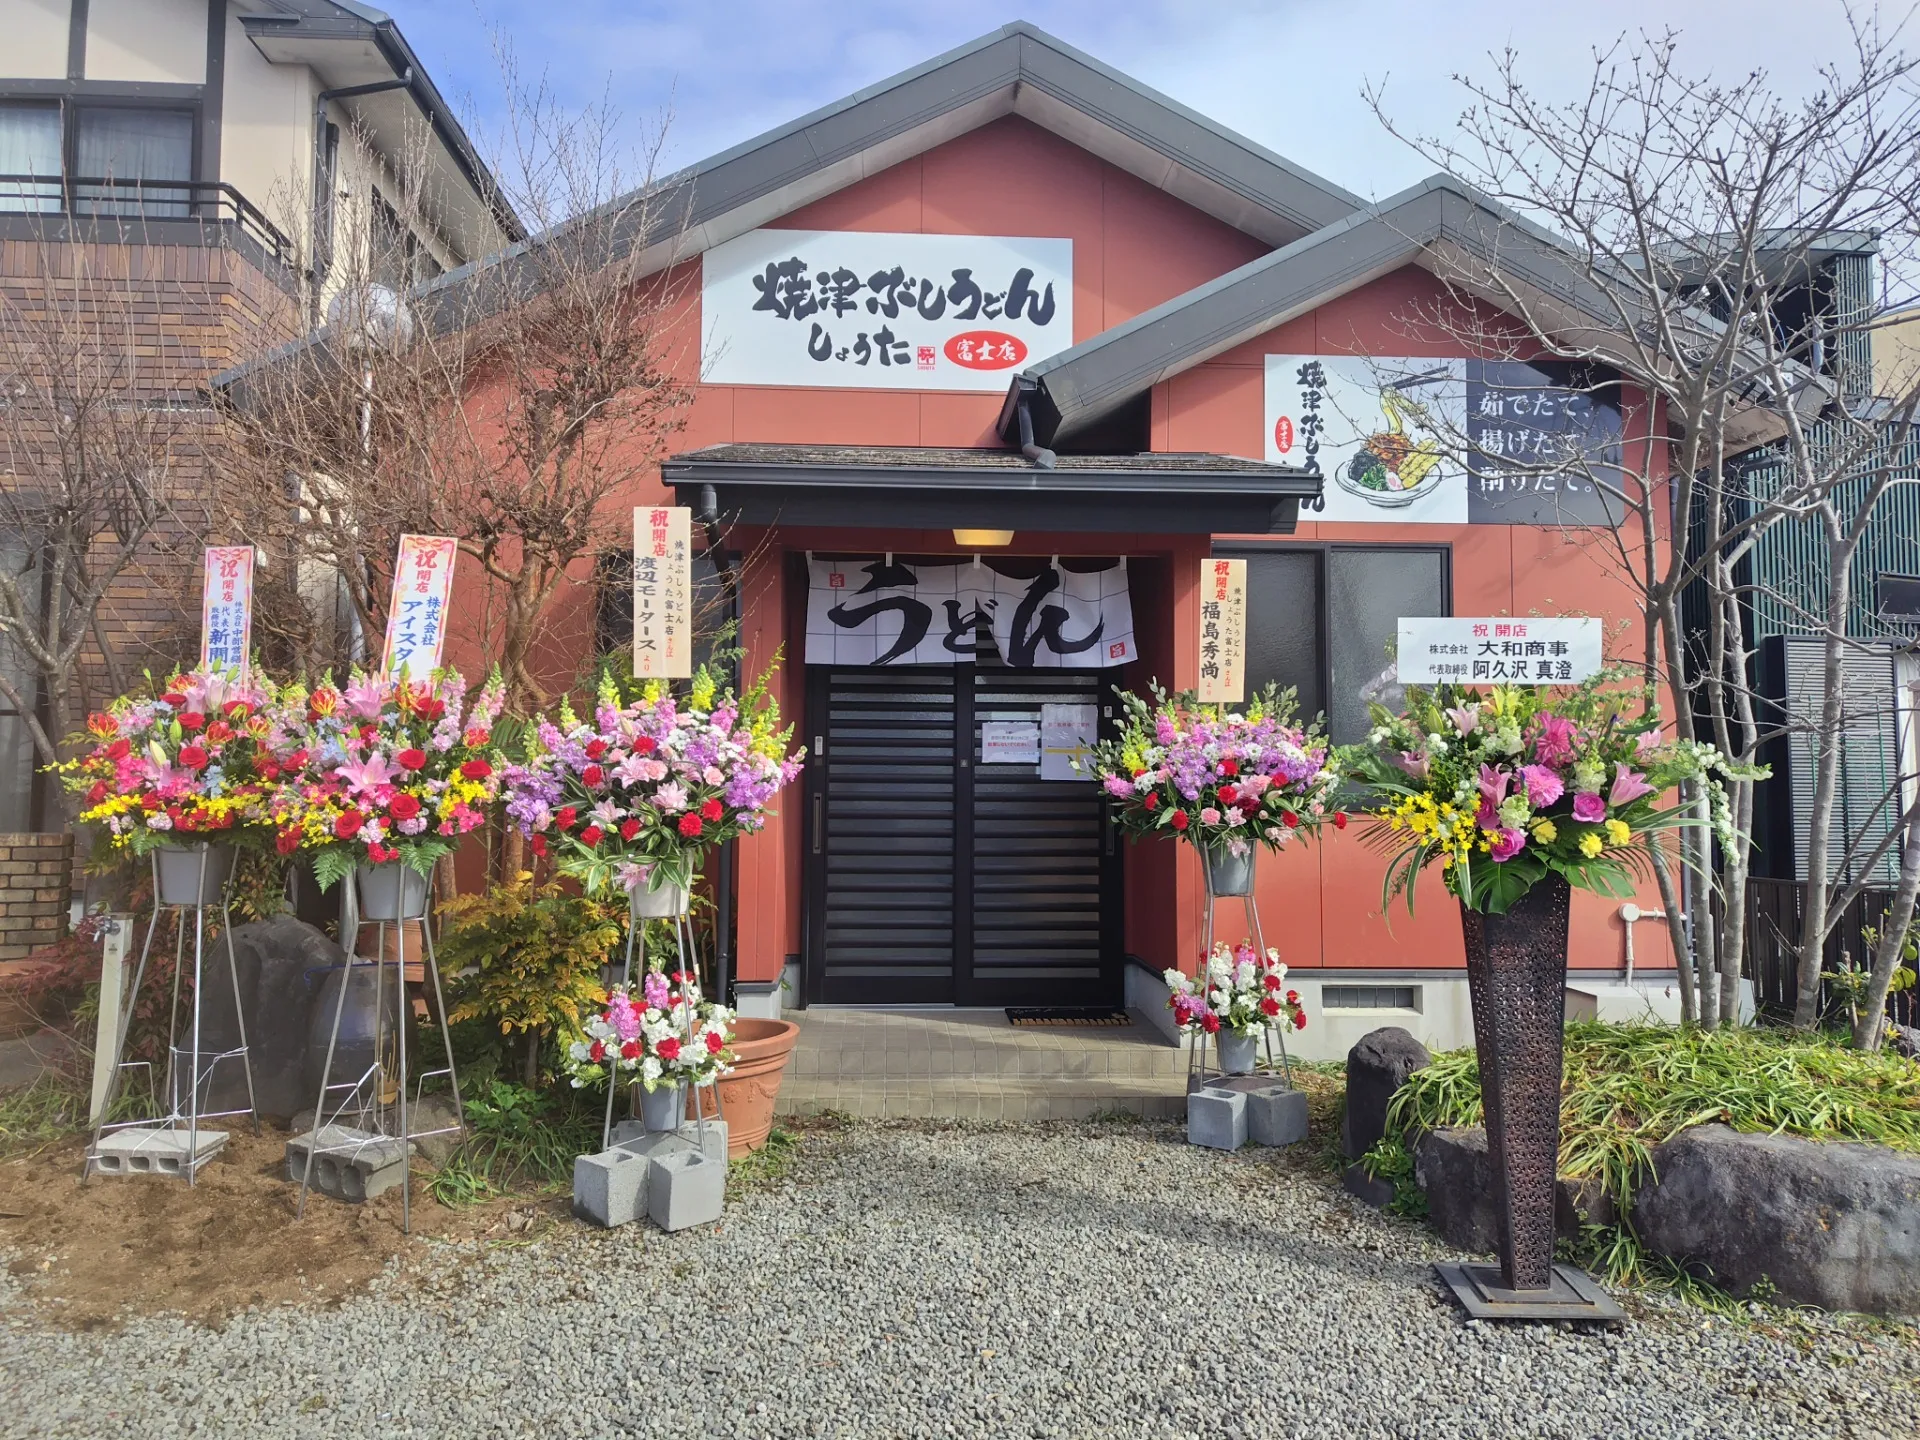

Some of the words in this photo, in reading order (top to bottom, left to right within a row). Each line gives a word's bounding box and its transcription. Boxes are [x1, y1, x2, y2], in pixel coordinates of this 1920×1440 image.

[752, 257, 1055, 325] 焼津ぶしうどん
[808, 323, 912, 366] しょうた
[957, 339, 1016, 361] 富士店
[650, 509, 669, 557] 祝開店
[220, 560, 238, 602] 祝開店
[415, 549, 437, 593] 祝開店
[674, 540, 685, 624] 焼津ぶしうどん
[1214, 560, 1230, 600] 祝開店
[422, 596, 441, 646] 株式会社
[635, 557, 658, 651] 渡辺モータース
[827, 561, 1104, 667] うどん
[1201, 601, 1221, 679] 福島秀尚
[1429, 644, 1468, 655] 株式会社
[1477, 640, 1569, 656] 大和商事
[1472, 624, 1489, 637] 祝
[1495, 624, 1527, 637] 開店
[1429, 664, 1468, 676] 代表取締役
[1473, 660, 1528, 679] 阿久沢
[1536, 660, 1572, 679] 真澄
